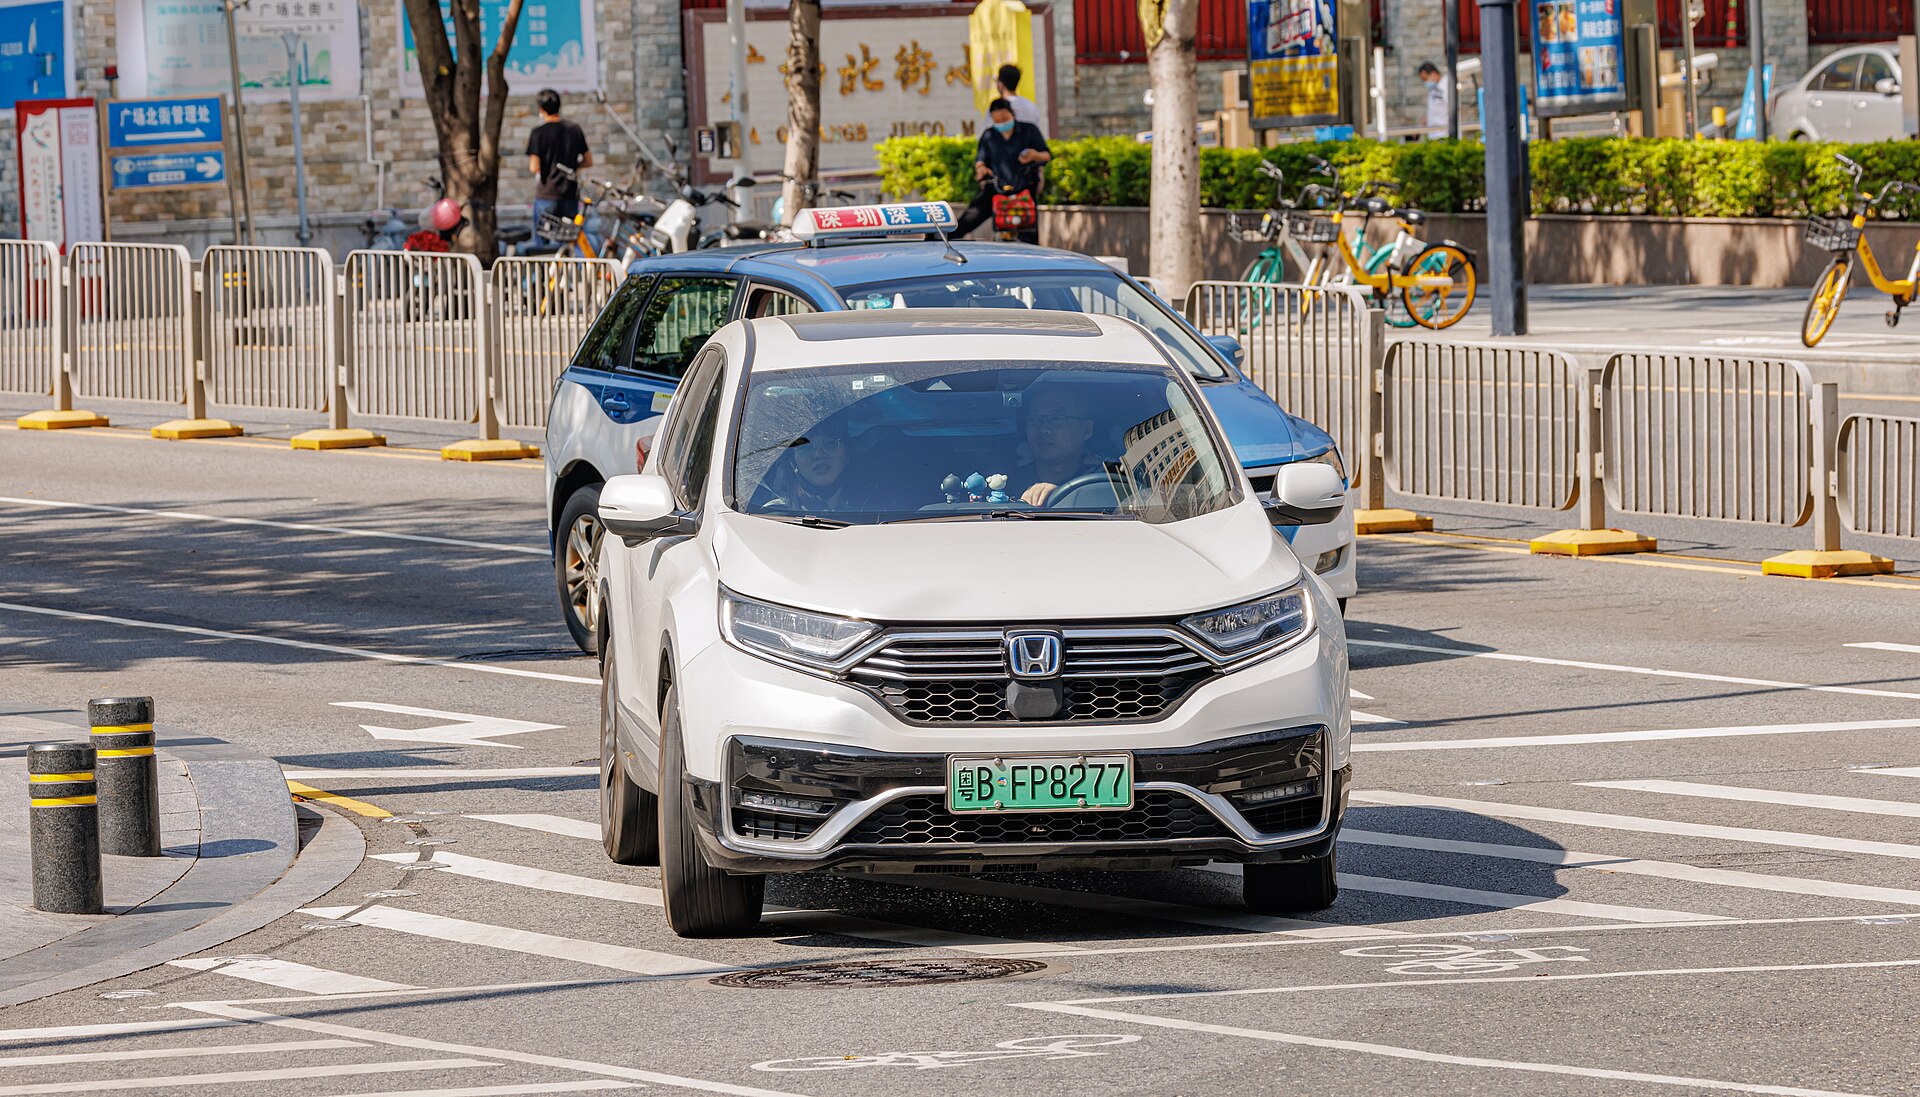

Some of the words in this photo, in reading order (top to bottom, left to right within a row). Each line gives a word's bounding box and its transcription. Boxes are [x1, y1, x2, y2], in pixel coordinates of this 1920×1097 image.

[259, 2, 321, 17] 广场北街
[119, 104, 211, 128] 广场北街管理处
[817, 207, 879, 228] 深圳
[886, 204, 947, 224] 深港
